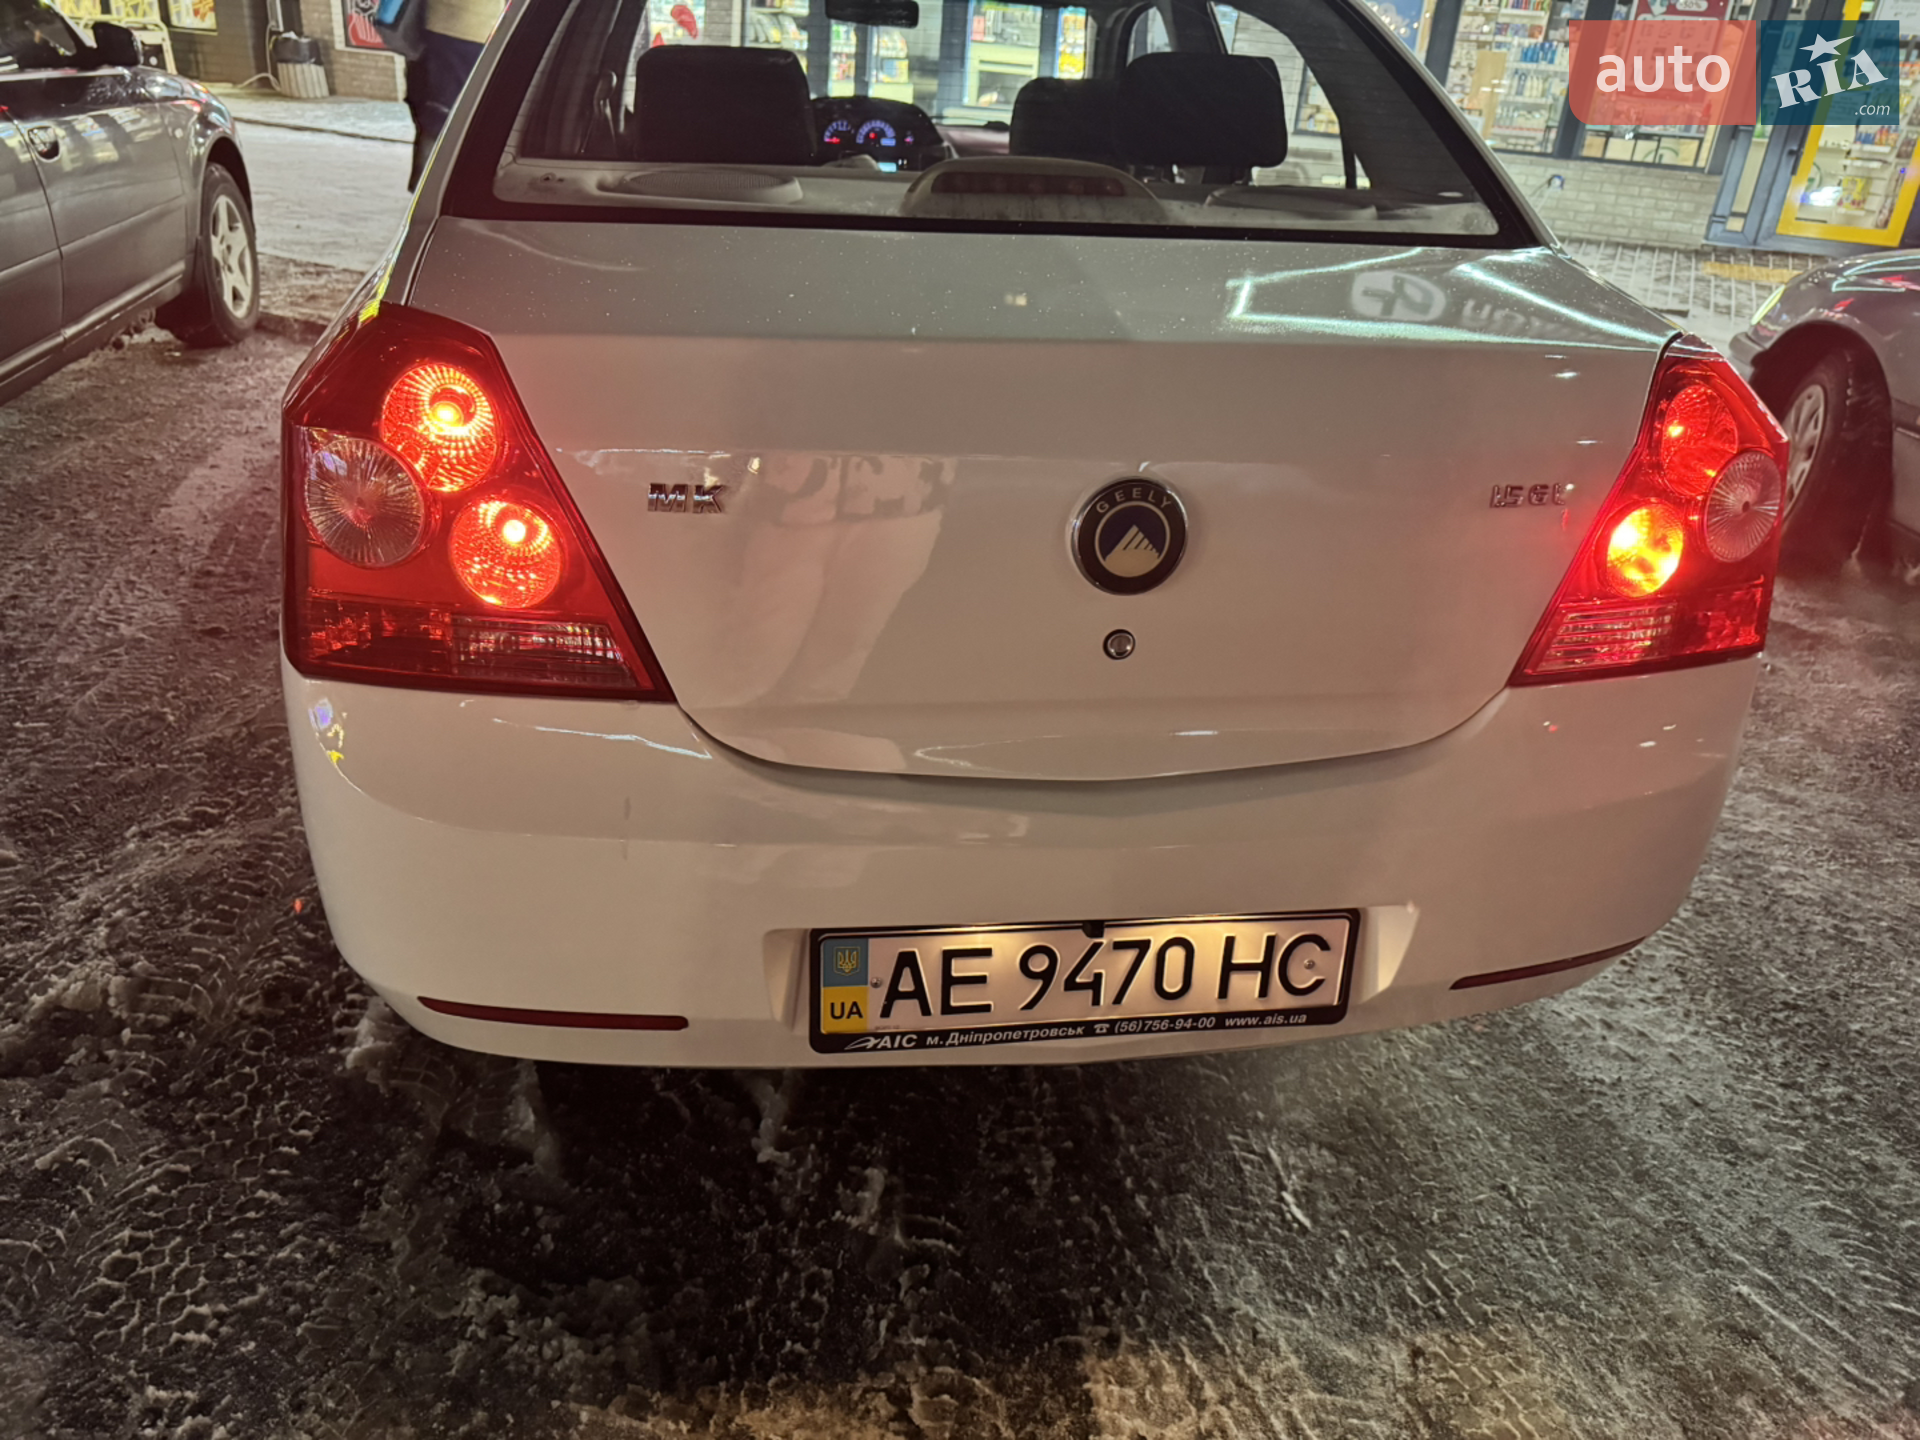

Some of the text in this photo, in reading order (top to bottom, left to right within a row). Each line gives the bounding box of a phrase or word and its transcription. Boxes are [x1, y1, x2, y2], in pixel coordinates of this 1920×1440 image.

[647, 483, 725, 514] MK
[1096, 487, 1172, 513] GEELY
[879, 932, 1332, 1019] AE 9470 HC
[830, 1002, 864, 1020] UA
[1224, 1013, 1307, 1028] www.ais.ua
